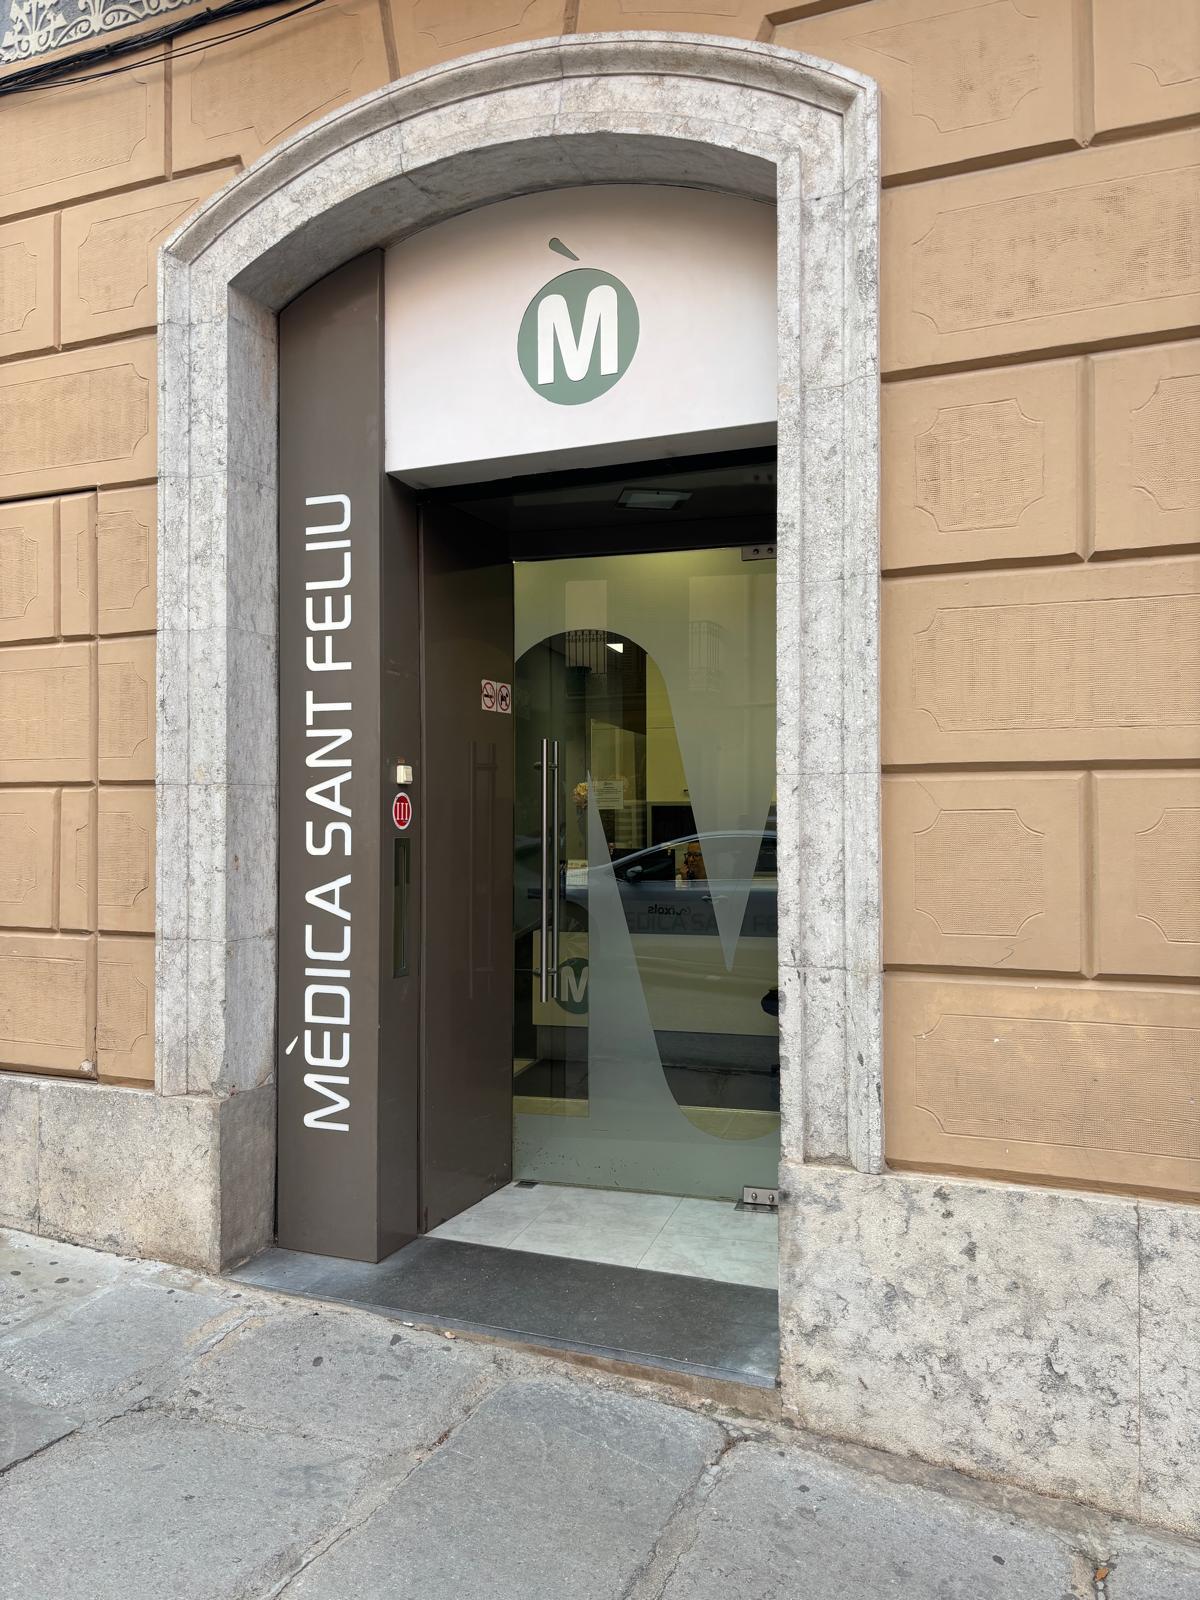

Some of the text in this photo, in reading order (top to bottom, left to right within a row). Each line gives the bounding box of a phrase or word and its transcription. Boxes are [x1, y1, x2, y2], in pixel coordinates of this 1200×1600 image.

[537, 284, 618, 385] M
[286, 493, 352, 1131] MÈDICA SANT FELIU
